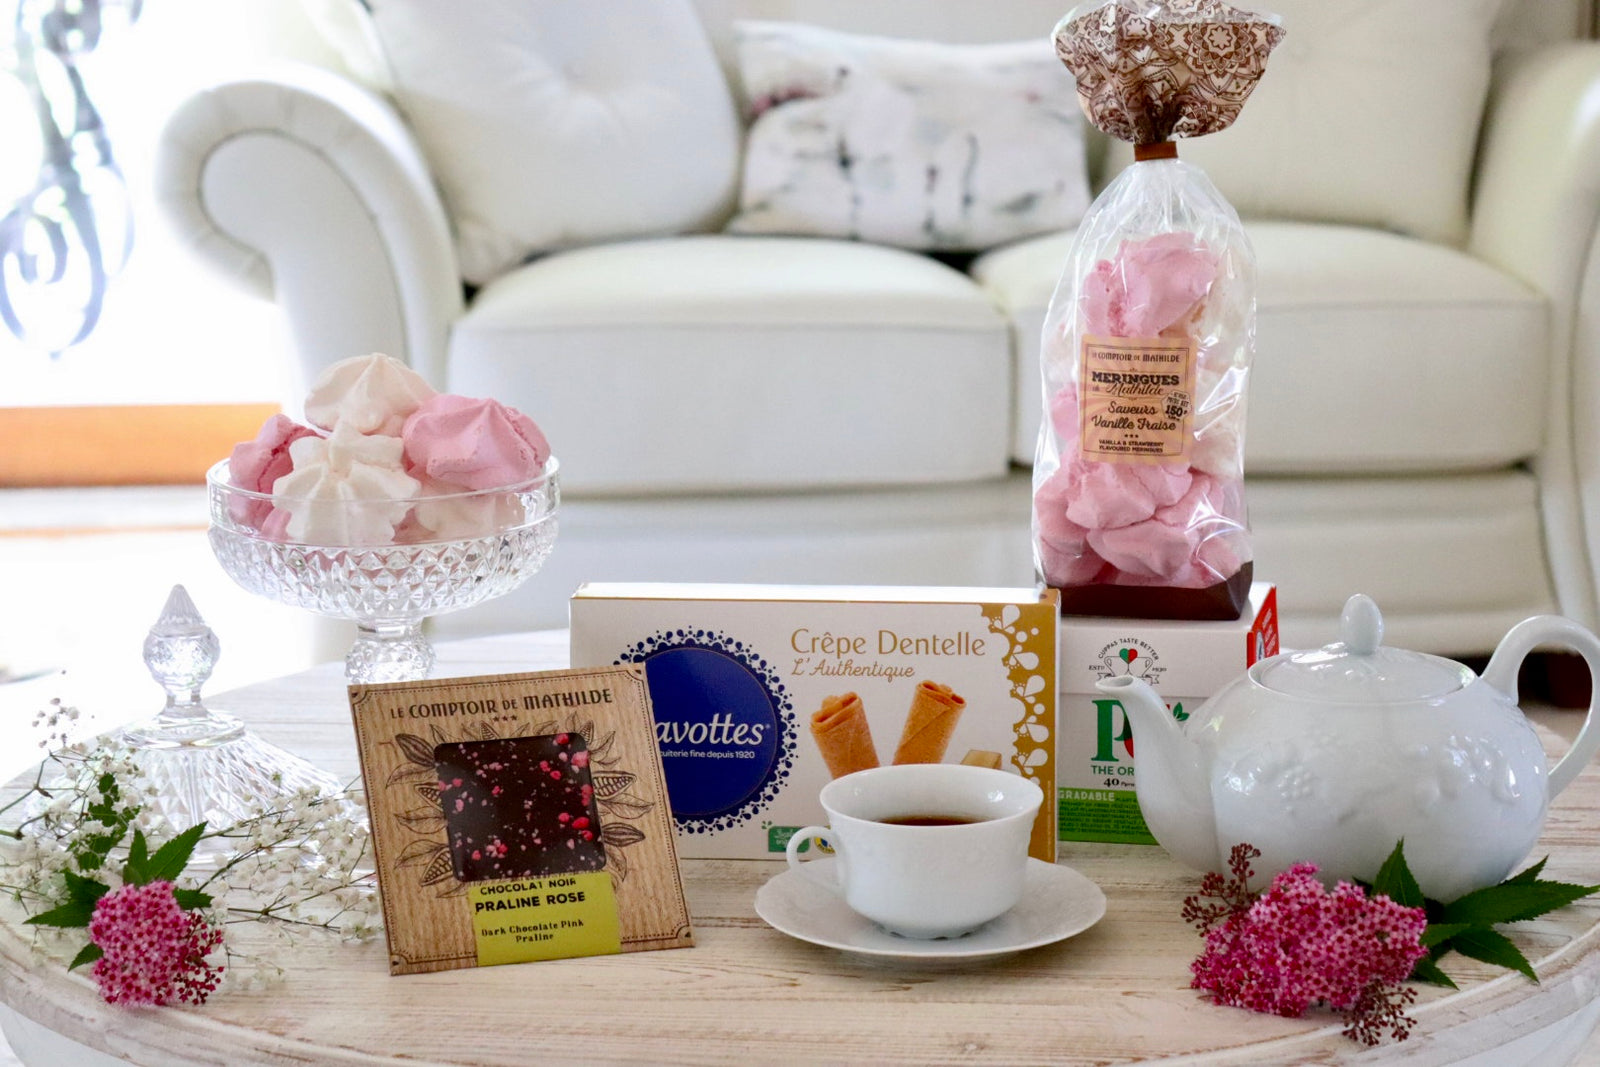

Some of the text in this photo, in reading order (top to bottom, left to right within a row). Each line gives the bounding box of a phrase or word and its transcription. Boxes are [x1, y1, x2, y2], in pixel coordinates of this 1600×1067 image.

[1098, 352, 1132, 361] COMPTOIR
[1142, 354, 1180, 362] MATHILDE
[1092, 371, 1180, 386] MERINGUES
[1106, 382, 1164, 397] Mathilde
[1107, 400, 1158, 415] Saveurs
[1091, 415, 1177, 431] Vanille Fraise
[791, 628, 986, 659] Crêpe Dentelle
[1098, 640, 1118, 659] CUPPAS
[1140, 641, 1159, 661] BETTER
[391, 688, 613, 719] LE COMPTOIR DE MATHILDE
[655, 713, 764, 745] avottes
[690, 750, 705, 758] fine
[707, 750, 734, 760] depuis
[735, 751, 755, 759] 1920
[1091, 765, 1134, 776] THE OR
[1103, 778, 1120, 787] 40
[1058, 790, 1115, 801] GRADABLE
[480, 878, 576, 896] CHOCOLAT NOIR
[475, 892, 586, 912] PRALINE ROSE
[481, 919, 584, 937] Dark Chocolate Pink
[516, 933, 554, 943] Praline
